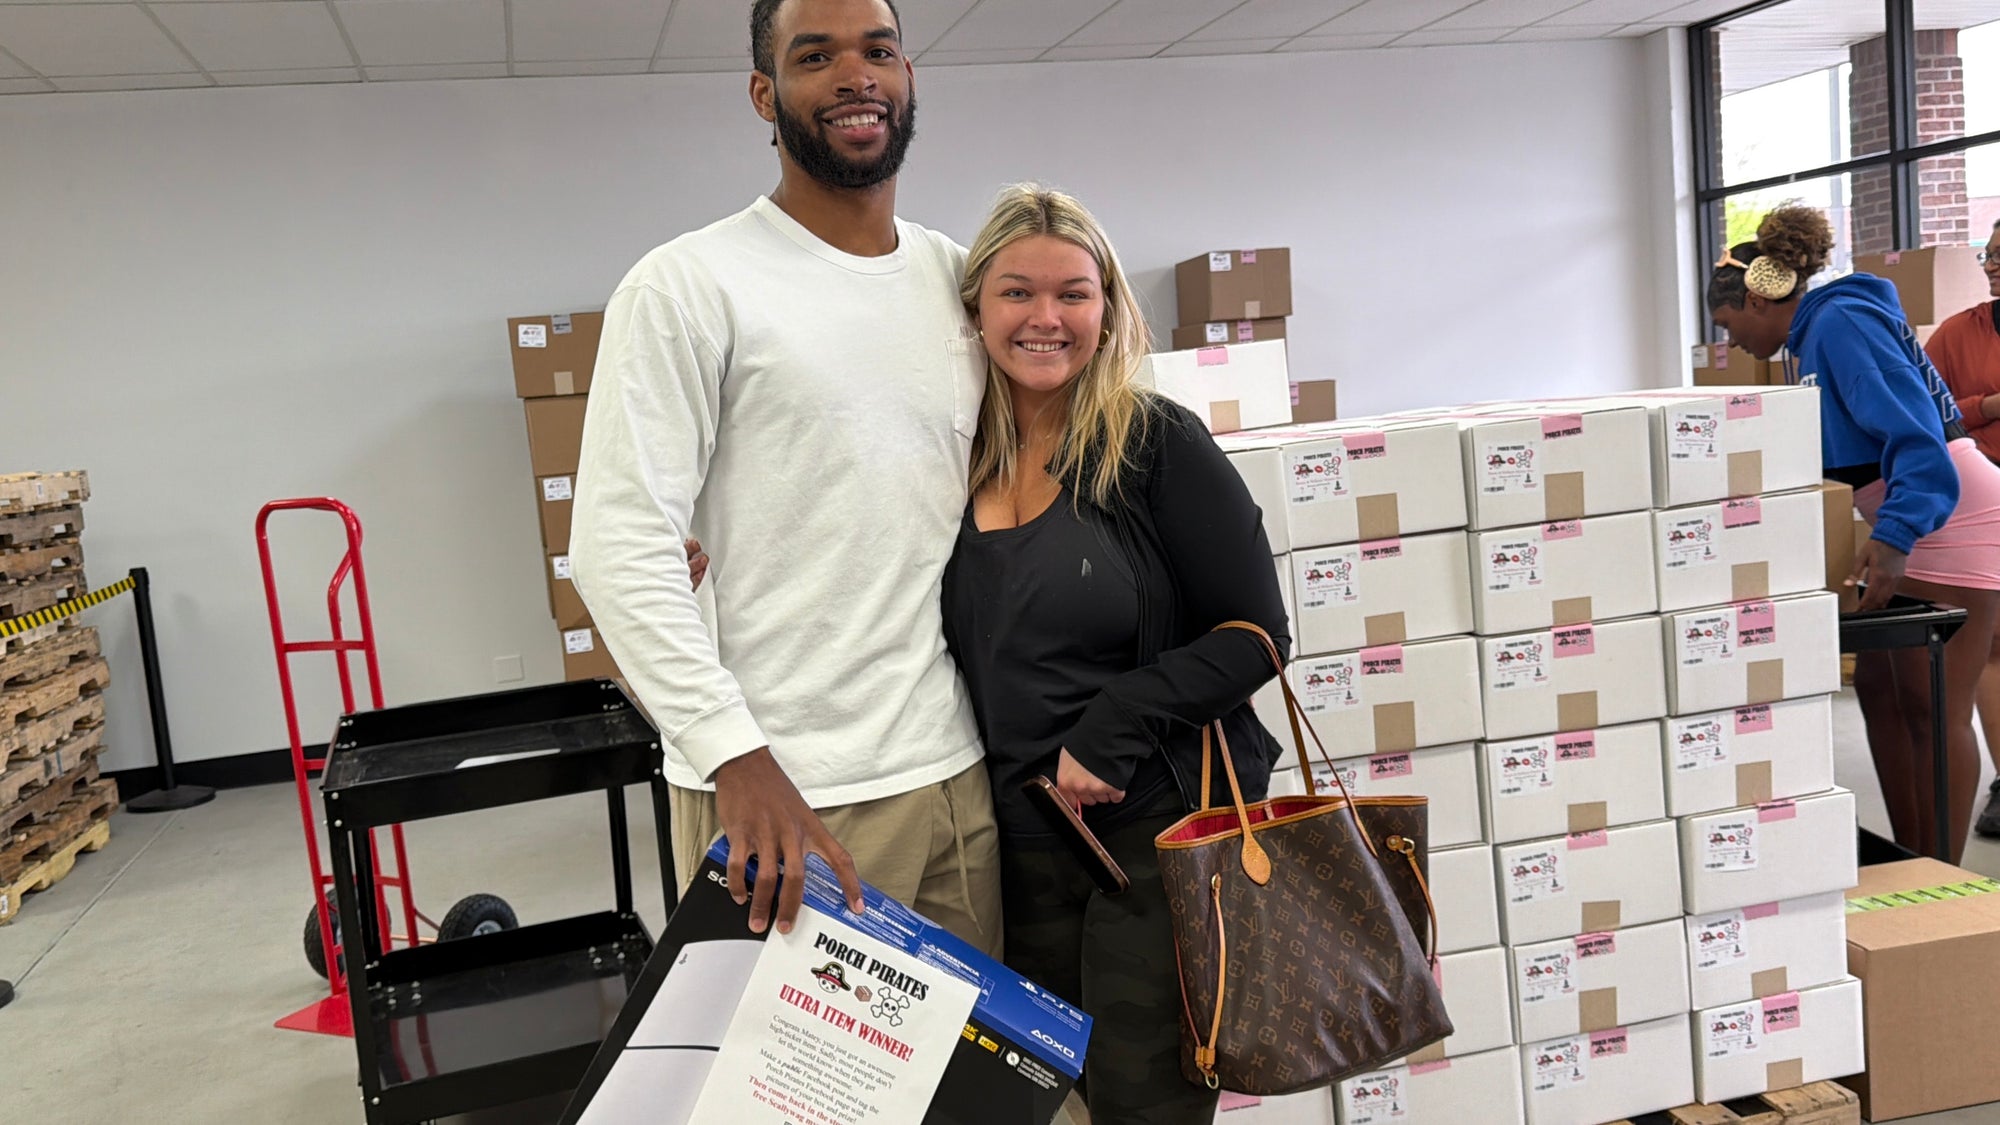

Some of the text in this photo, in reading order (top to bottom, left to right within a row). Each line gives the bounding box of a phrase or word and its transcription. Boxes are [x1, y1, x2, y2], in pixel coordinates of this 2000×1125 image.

[865, 906, 917, 938] AVERTISSEMENT
[814, 932, 868, 970] PORCH
[866, 958, 930, 1001] PIRATES
[936, 944, 980, 976] ADVERTENCIA
[773, 1014, 800, 1033] Congrats
[821, 1040, 835, 1050] you
[834, 1046, 848, 1056] just
[846, 1052, 859, 1062] got
[867, 1063, 896, 1080] awesome
[779, 984, 914, 1062] ULTRA ITEM WINNER!
[980, 1038, 996, 1050] HDR
[760, 1048, 777, 1062] Make
[780, 1062, 803, 1075] public
[802, 1070, 831, 1090] Facebook
[831, 1087, 846, 1098] post
[845, 1094, 859, 1104] and
[858, 1100, 868, 1110] tag
[869, 1105, 880, 1114] the
[777, 1036, 876, 1092] let the world know when they get
[792, 1056, 824, 1076] something
[838, 1058, 854, 1070] most
[853, 1066, 875, 1081] people
[749, 1075, 768, 1091] Then
[767, 1087, 788, 1101] come
[788, 1095, 806, 1111] back
[816, 1111, 829, 1122] the
[752, 1090, 768, 1103] free
[768, 1098, 805, 1124] Scallywag
[765, 1062, 865, 1118] Porch Pirates Facebook page with
[765, 1074, 790, 1090] pictures
[798, 1091, 814, 1102] your
[813, 1097, 825, 1109] box
[826, 1105, 839, 1115] and
[837, 1111, 857, 1124] prize!
